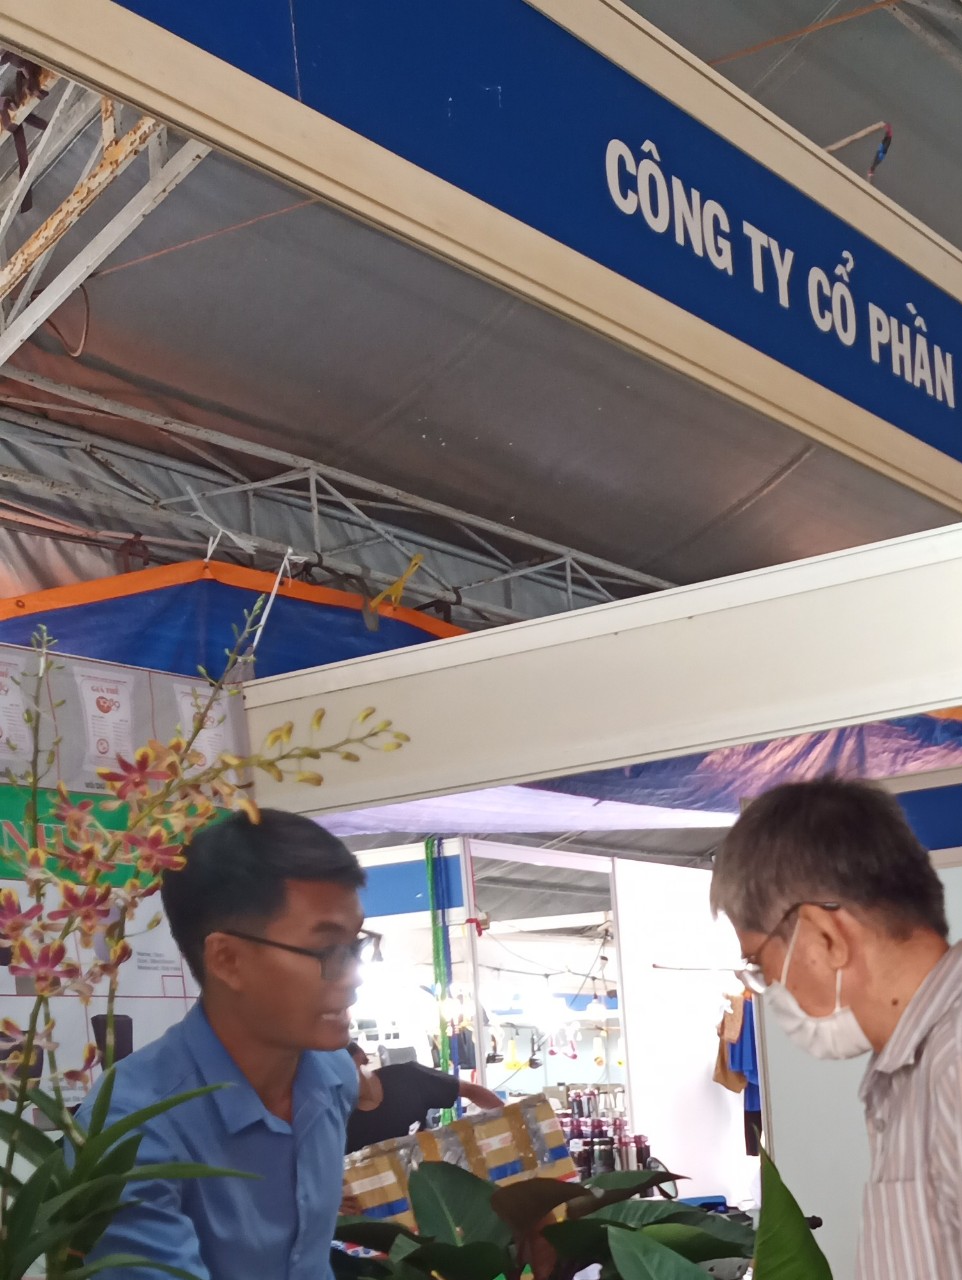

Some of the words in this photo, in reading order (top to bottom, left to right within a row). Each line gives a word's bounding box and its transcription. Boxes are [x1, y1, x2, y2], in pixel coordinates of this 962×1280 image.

[606, 138, 733, 276] CÔNG
[742, 220, 795, 309] TY
[808, 250, 857, 347] CỔ
[868, 302, 955, 409] PHẦN
